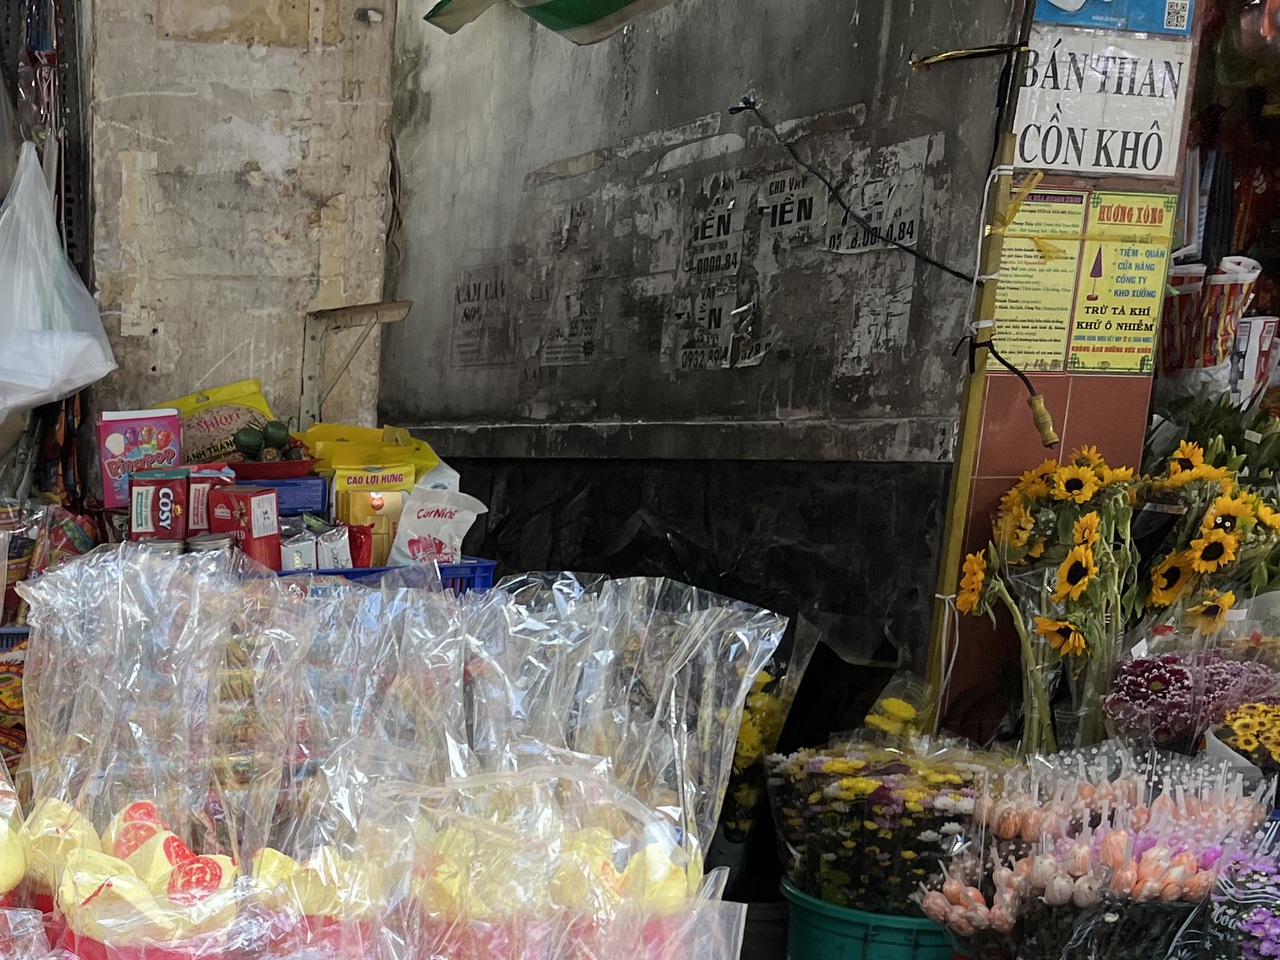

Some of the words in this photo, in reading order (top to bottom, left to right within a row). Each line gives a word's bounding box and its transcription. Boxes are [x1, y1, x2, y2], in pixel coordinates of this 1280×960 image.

[1023, 38, 1089, 92] BÁN
[1097, 55, 1184, 100] THAN
[1020, 103, 1086, 167] CỒN
[1092, 120, 1162, 171] KHÔ
[1138, 276, 1147, 285] TY
[1113, 289, 1129, 298] KHO
[1130, 306, 1151, 316] KHÍ
[1105, 320, 1112, 330] Ô
[346, 475, 363, 485] CAO
[158, 487, 174, 530] COSY
